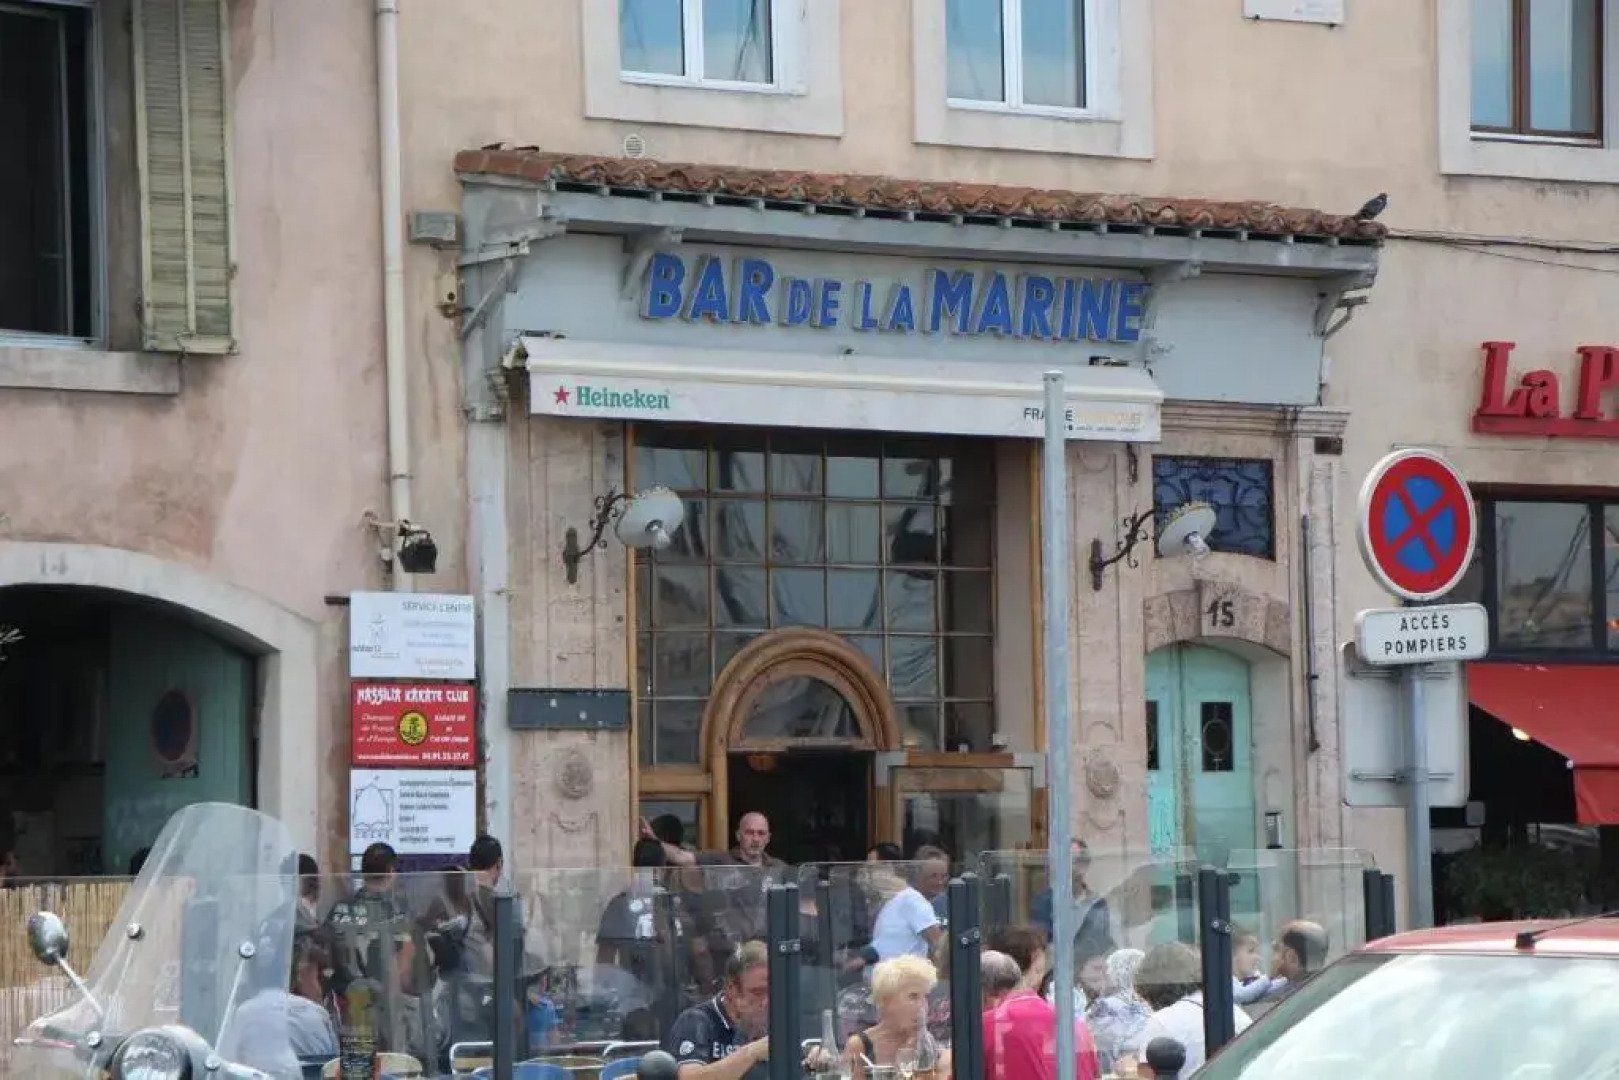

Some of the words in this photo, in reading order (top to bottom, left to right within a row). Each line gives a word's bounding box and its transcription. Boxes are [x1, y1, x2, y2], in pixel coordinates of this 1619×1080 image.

[641, 252, 774, 326] BAR
[779, 275, 842, 328] DE
[854, 277, 915, 333] LA
[923, 267, 1147, 344] MARINE
[1478, 341, 1558, 418] La
[576, 385, 670, 408] Heineken
[1208, 599, 1235, 627] 15
[1384, 636, 1467, 655] POMPIERS
